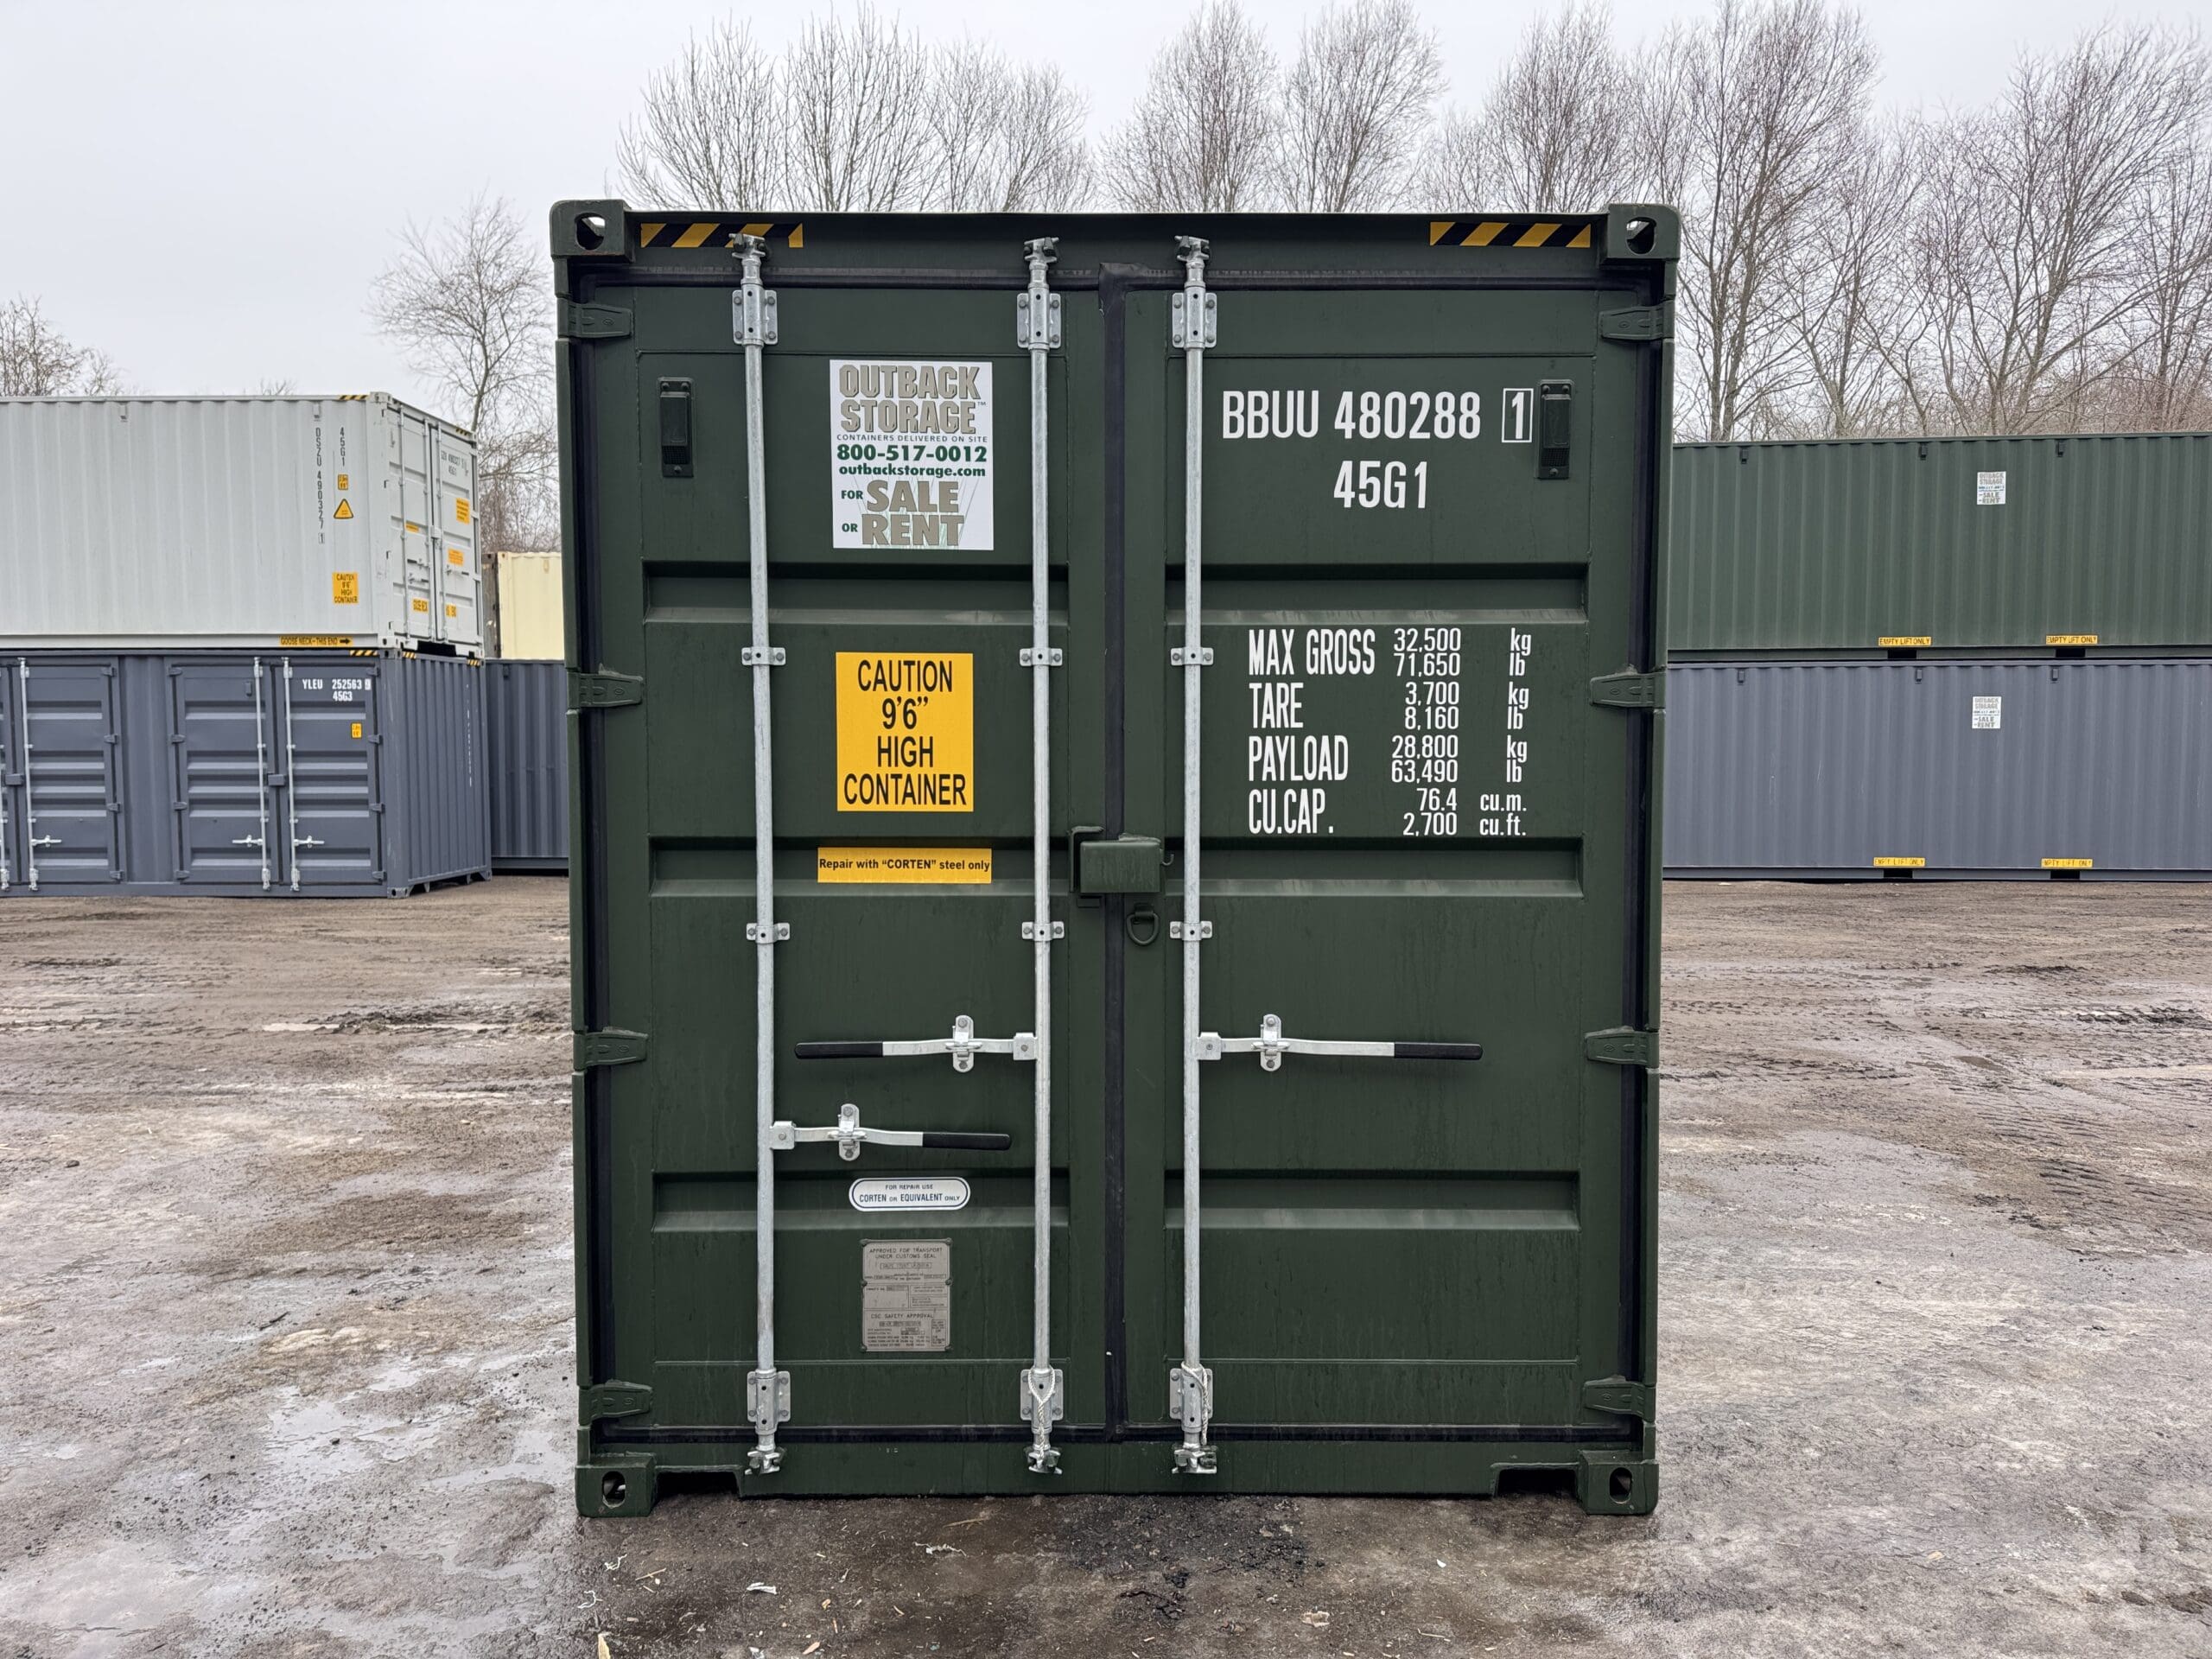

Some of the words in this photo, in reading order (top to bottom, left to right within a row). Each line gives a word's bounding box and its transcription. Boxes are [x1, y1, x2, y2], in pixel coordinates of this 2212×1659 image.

[839, 365, 981, 399] OUTBACK
[840, 399, 976, 434] STORAGE
[1223, 391, 1319, 438] BBUU
[1335, 391, 1480, 439] 480288
[836, 444, 987, 462] 800-517-0012
[839, 463, 985, 478] outbackstorage.com
[1334, 461, 1427, 508] 45G1
[841, 490, 863, 499] FOR
[867, 480, 959, 512] SALE
[842, 523, 858, 532] OR
[861, 514, 964, 546] RENT
[1249, 629, 1294, 675] MAX
[1306, 629, 1375, 675] GROSS
[1394, 628, 1461, 652] 32,500
[1510, 627, 1532, 656] kg
[1394, 653, 1461, 677] 71,650
[1509, 654, 1526, 676] lb
[302, 679, 323, 690] YLEU
[331, 679, 362, 690] 252563
[857, 660, 952, 692] CAUTION
[332, 691, 353, 702] 45G3
[1249, 683, 1303, 728] TARE
[1403, 681, 1461, 705] 3,700
[1508, 681, 1530, 709] kg
[1403, 706, 1460, 730] 8,160
[1507, 706, 1524, 729] lb
[877, 736, 934, 767] HIGH
[1249, 735, 1348, 781] PAYLOAD
[1391, 734, 1459, 759] 28,800
[1506, 734, 1529, 763] kg
[1390, 760, 1459, 784] 63,490
[1505, 760, 1522, 783] lb
[843, 773, 967, 805] CONTAINER
[1415, 787, 1458, 812] 76.4
[1478, 791, 1527, 812] cu.m.
[1402, 812, 1458, 836] 2,700
[1478, 814, 1527, 836] cu.ft.
[820, 858, 853, 870] Repair
[856, 859, 879, 869] with
[939, 860, 965, 870] steel
[968, 860, 990, 872] only
[901, 1193, 942, 1201] EQUIVALENT
